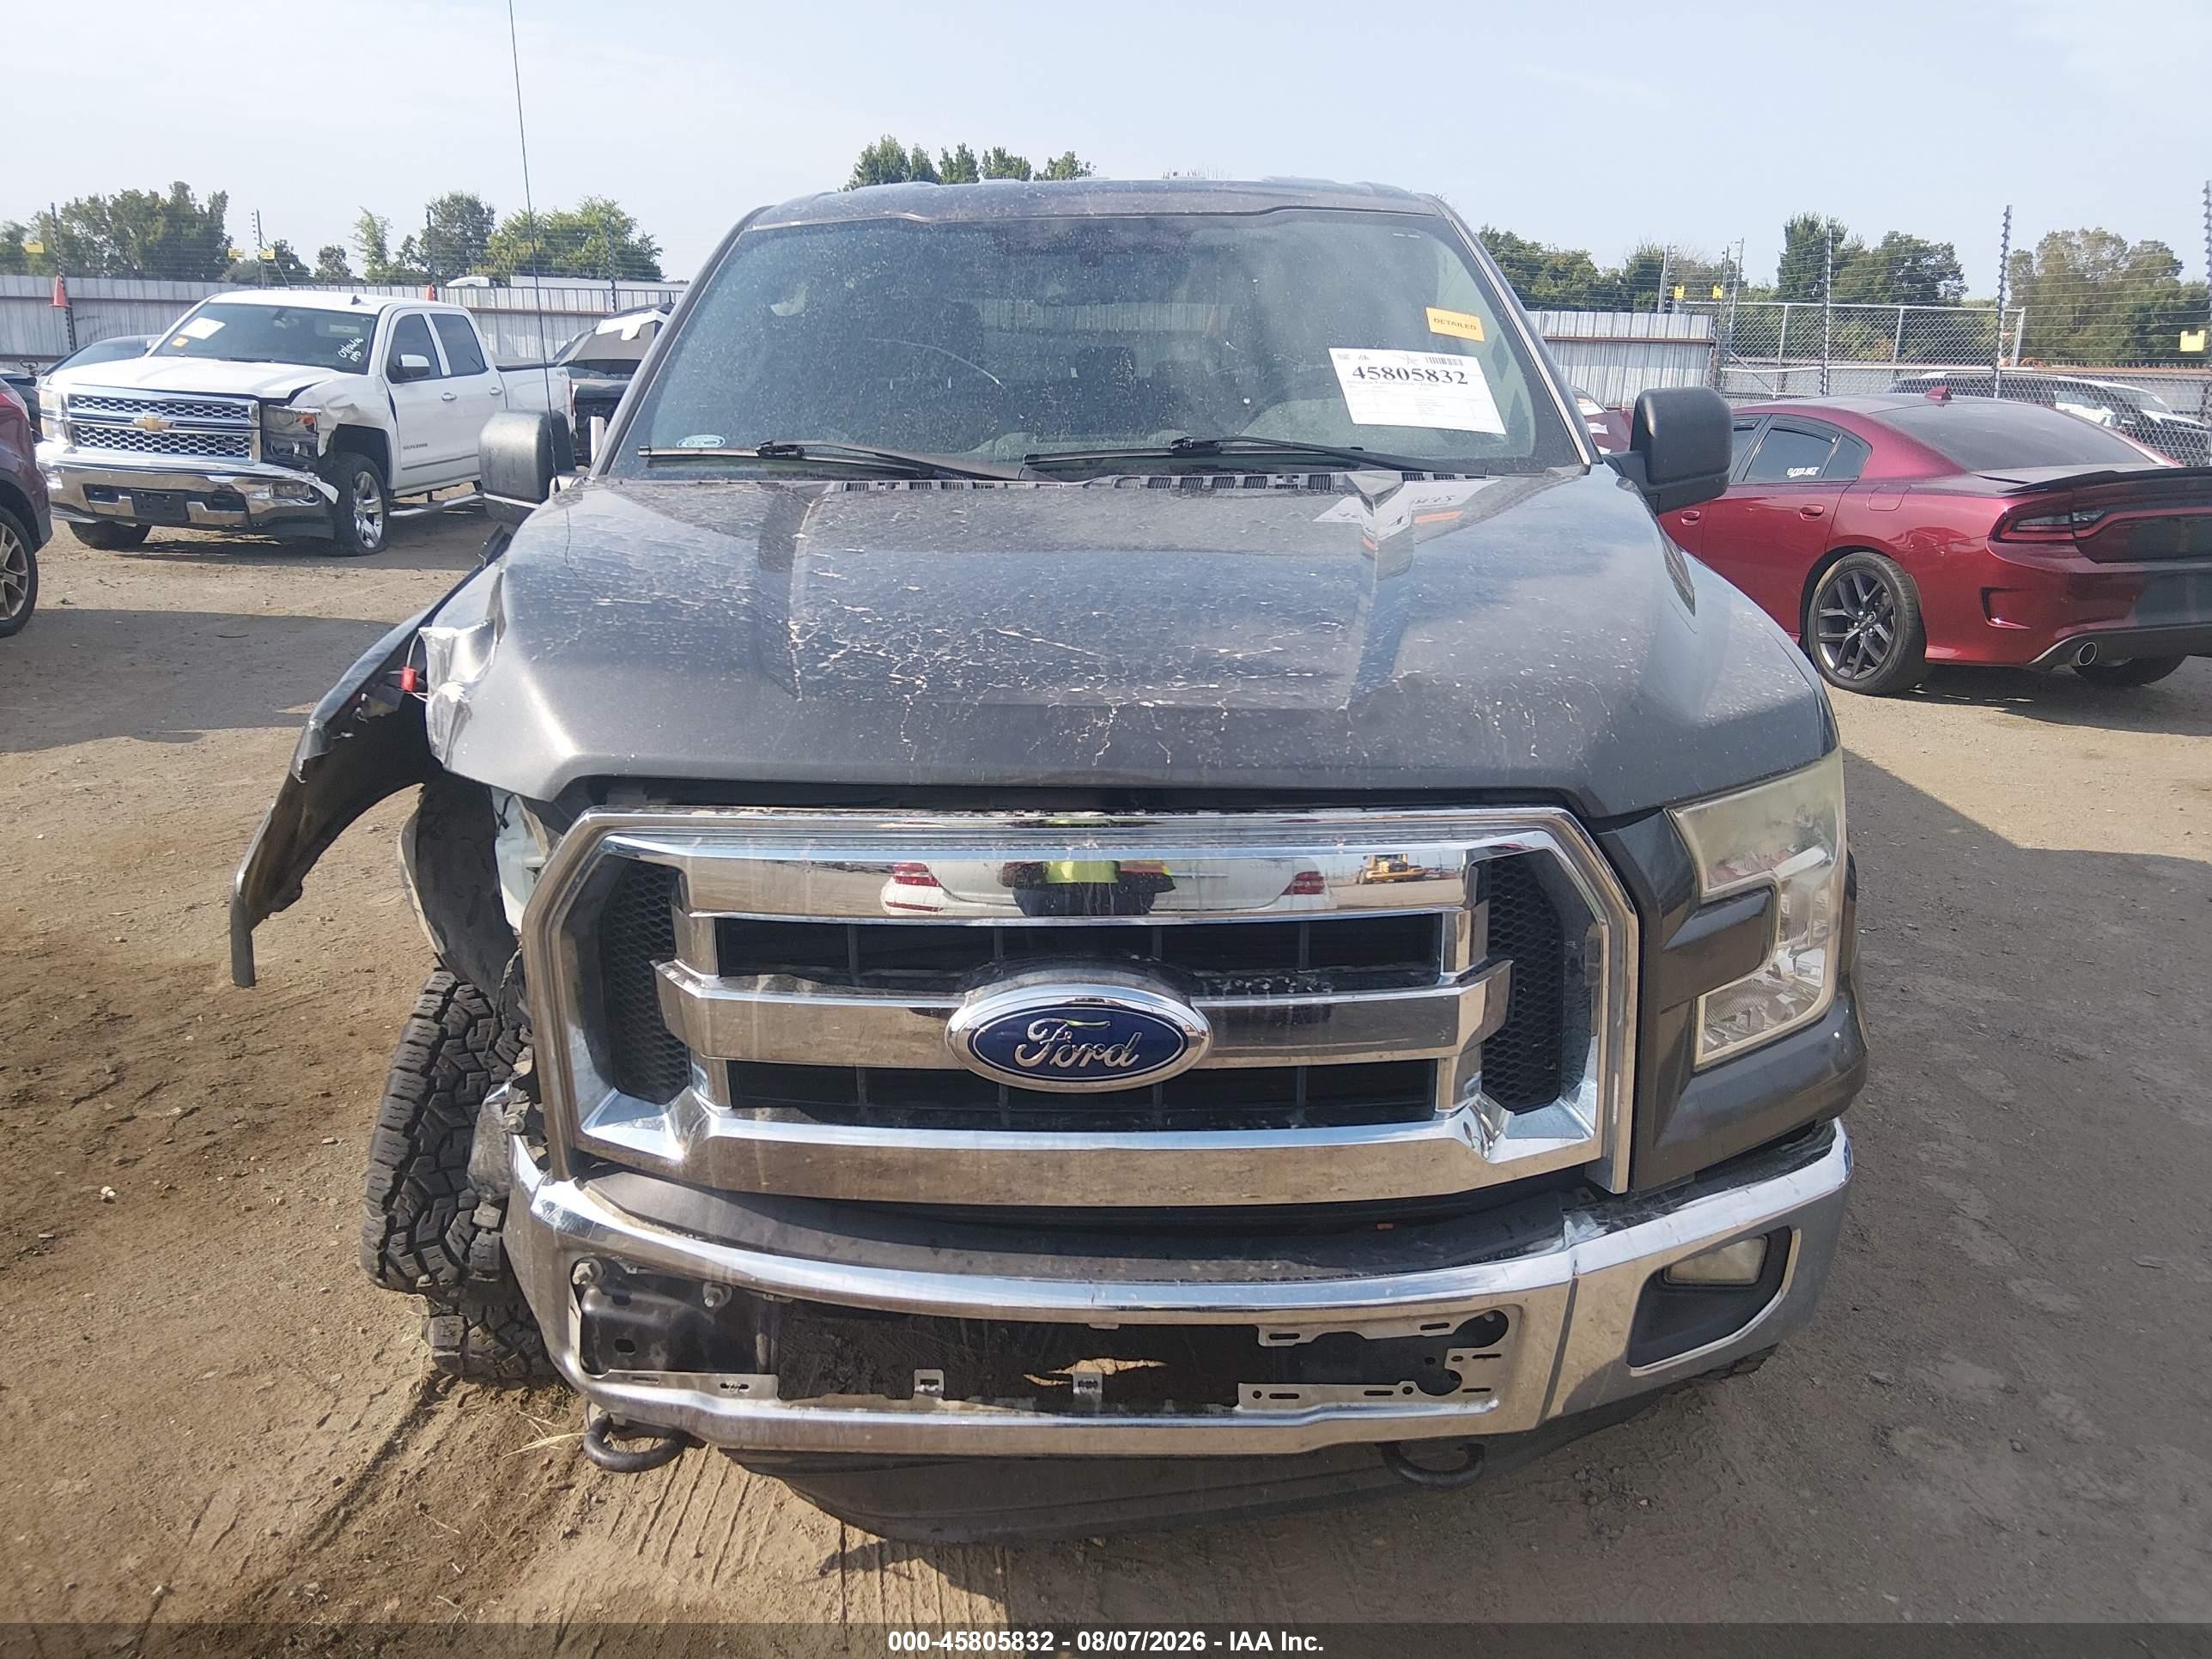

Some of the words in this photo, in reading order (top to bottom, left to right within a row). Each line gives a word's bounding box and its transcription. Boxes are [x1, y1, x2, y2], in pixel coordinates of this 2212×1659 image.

[1433, 318, 1477, 331] DETAILED
[1352, 367, 1468, 386] 45805832
[1014, 1018, 1142, 1068] Ford
